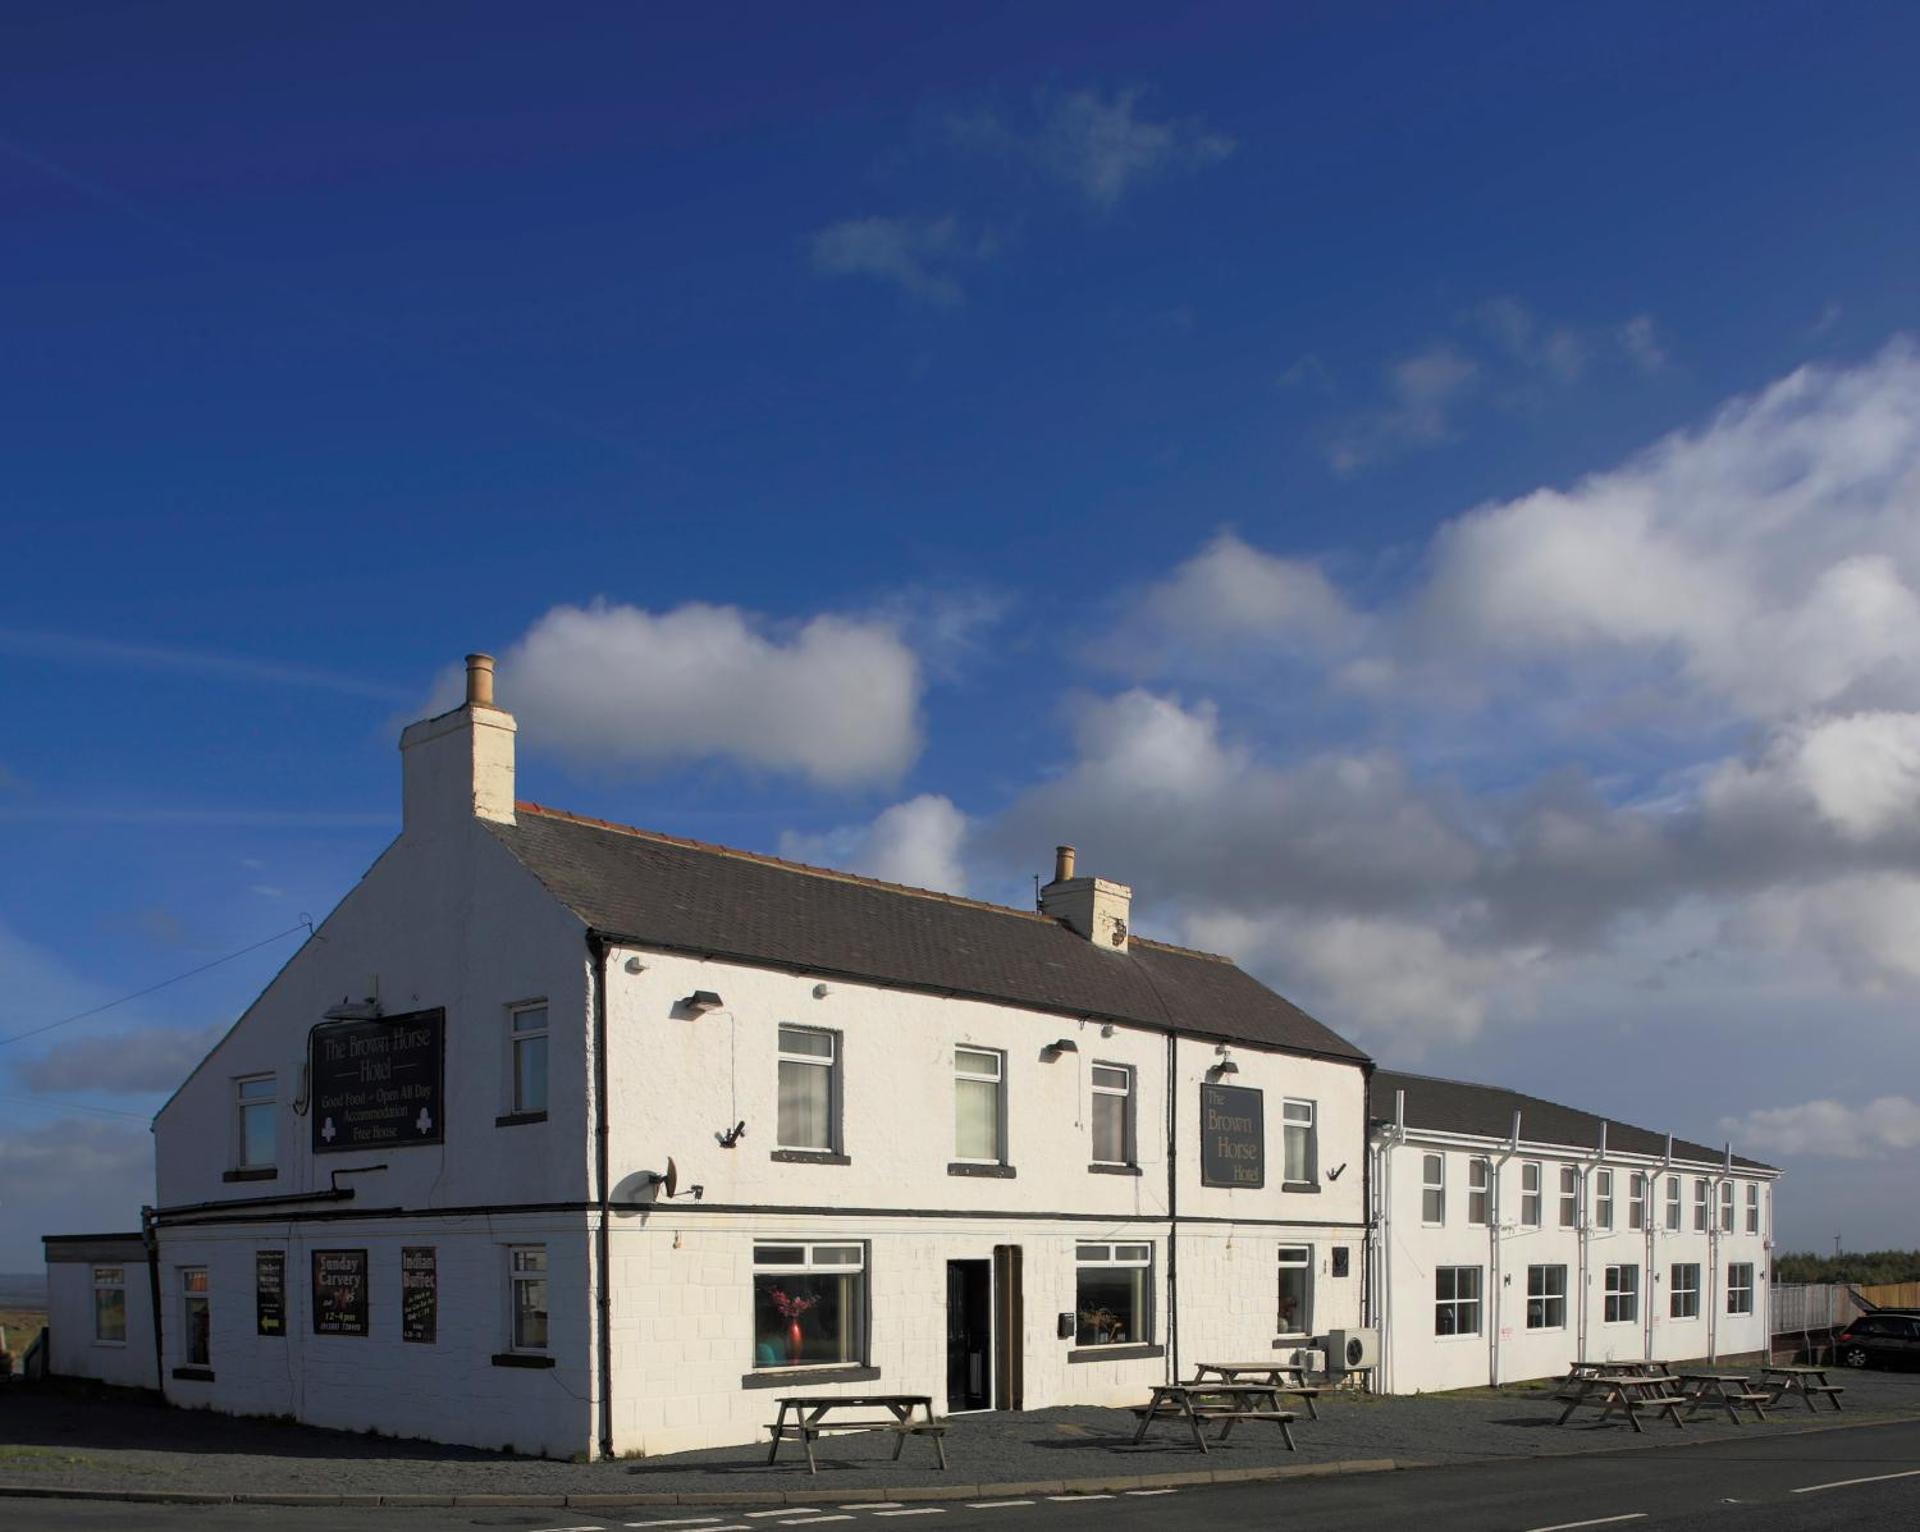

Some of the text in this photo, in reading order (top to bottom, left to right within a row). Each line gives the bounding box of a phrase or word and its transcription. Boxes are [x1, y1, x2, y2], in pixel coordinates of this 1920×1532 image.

[323, 1026, 432, 1060] The Brown Horse
[360, 1057, 392, 1082] Hotel
[321, 1093, 343, 1109] Good
[345, 1090, 367, 1106] Food
[376, 1087, 400, 1105] Open
[401, 1084, 414, 1100] All
[415, 1083, 433, 1101] Day
[1208, 1089, 1225, 1105] The
[1208, 1108, 1253, 1134] Brown
[1217, 1136, 1257, 1161] Horse
[1233, 1165, 1259, 1182] Hotel
[320, 1255, 360, 1273] Sunday
[403, 1251, 434, 1270] Indian
[319, 1271, 361, 1288] Carvery
